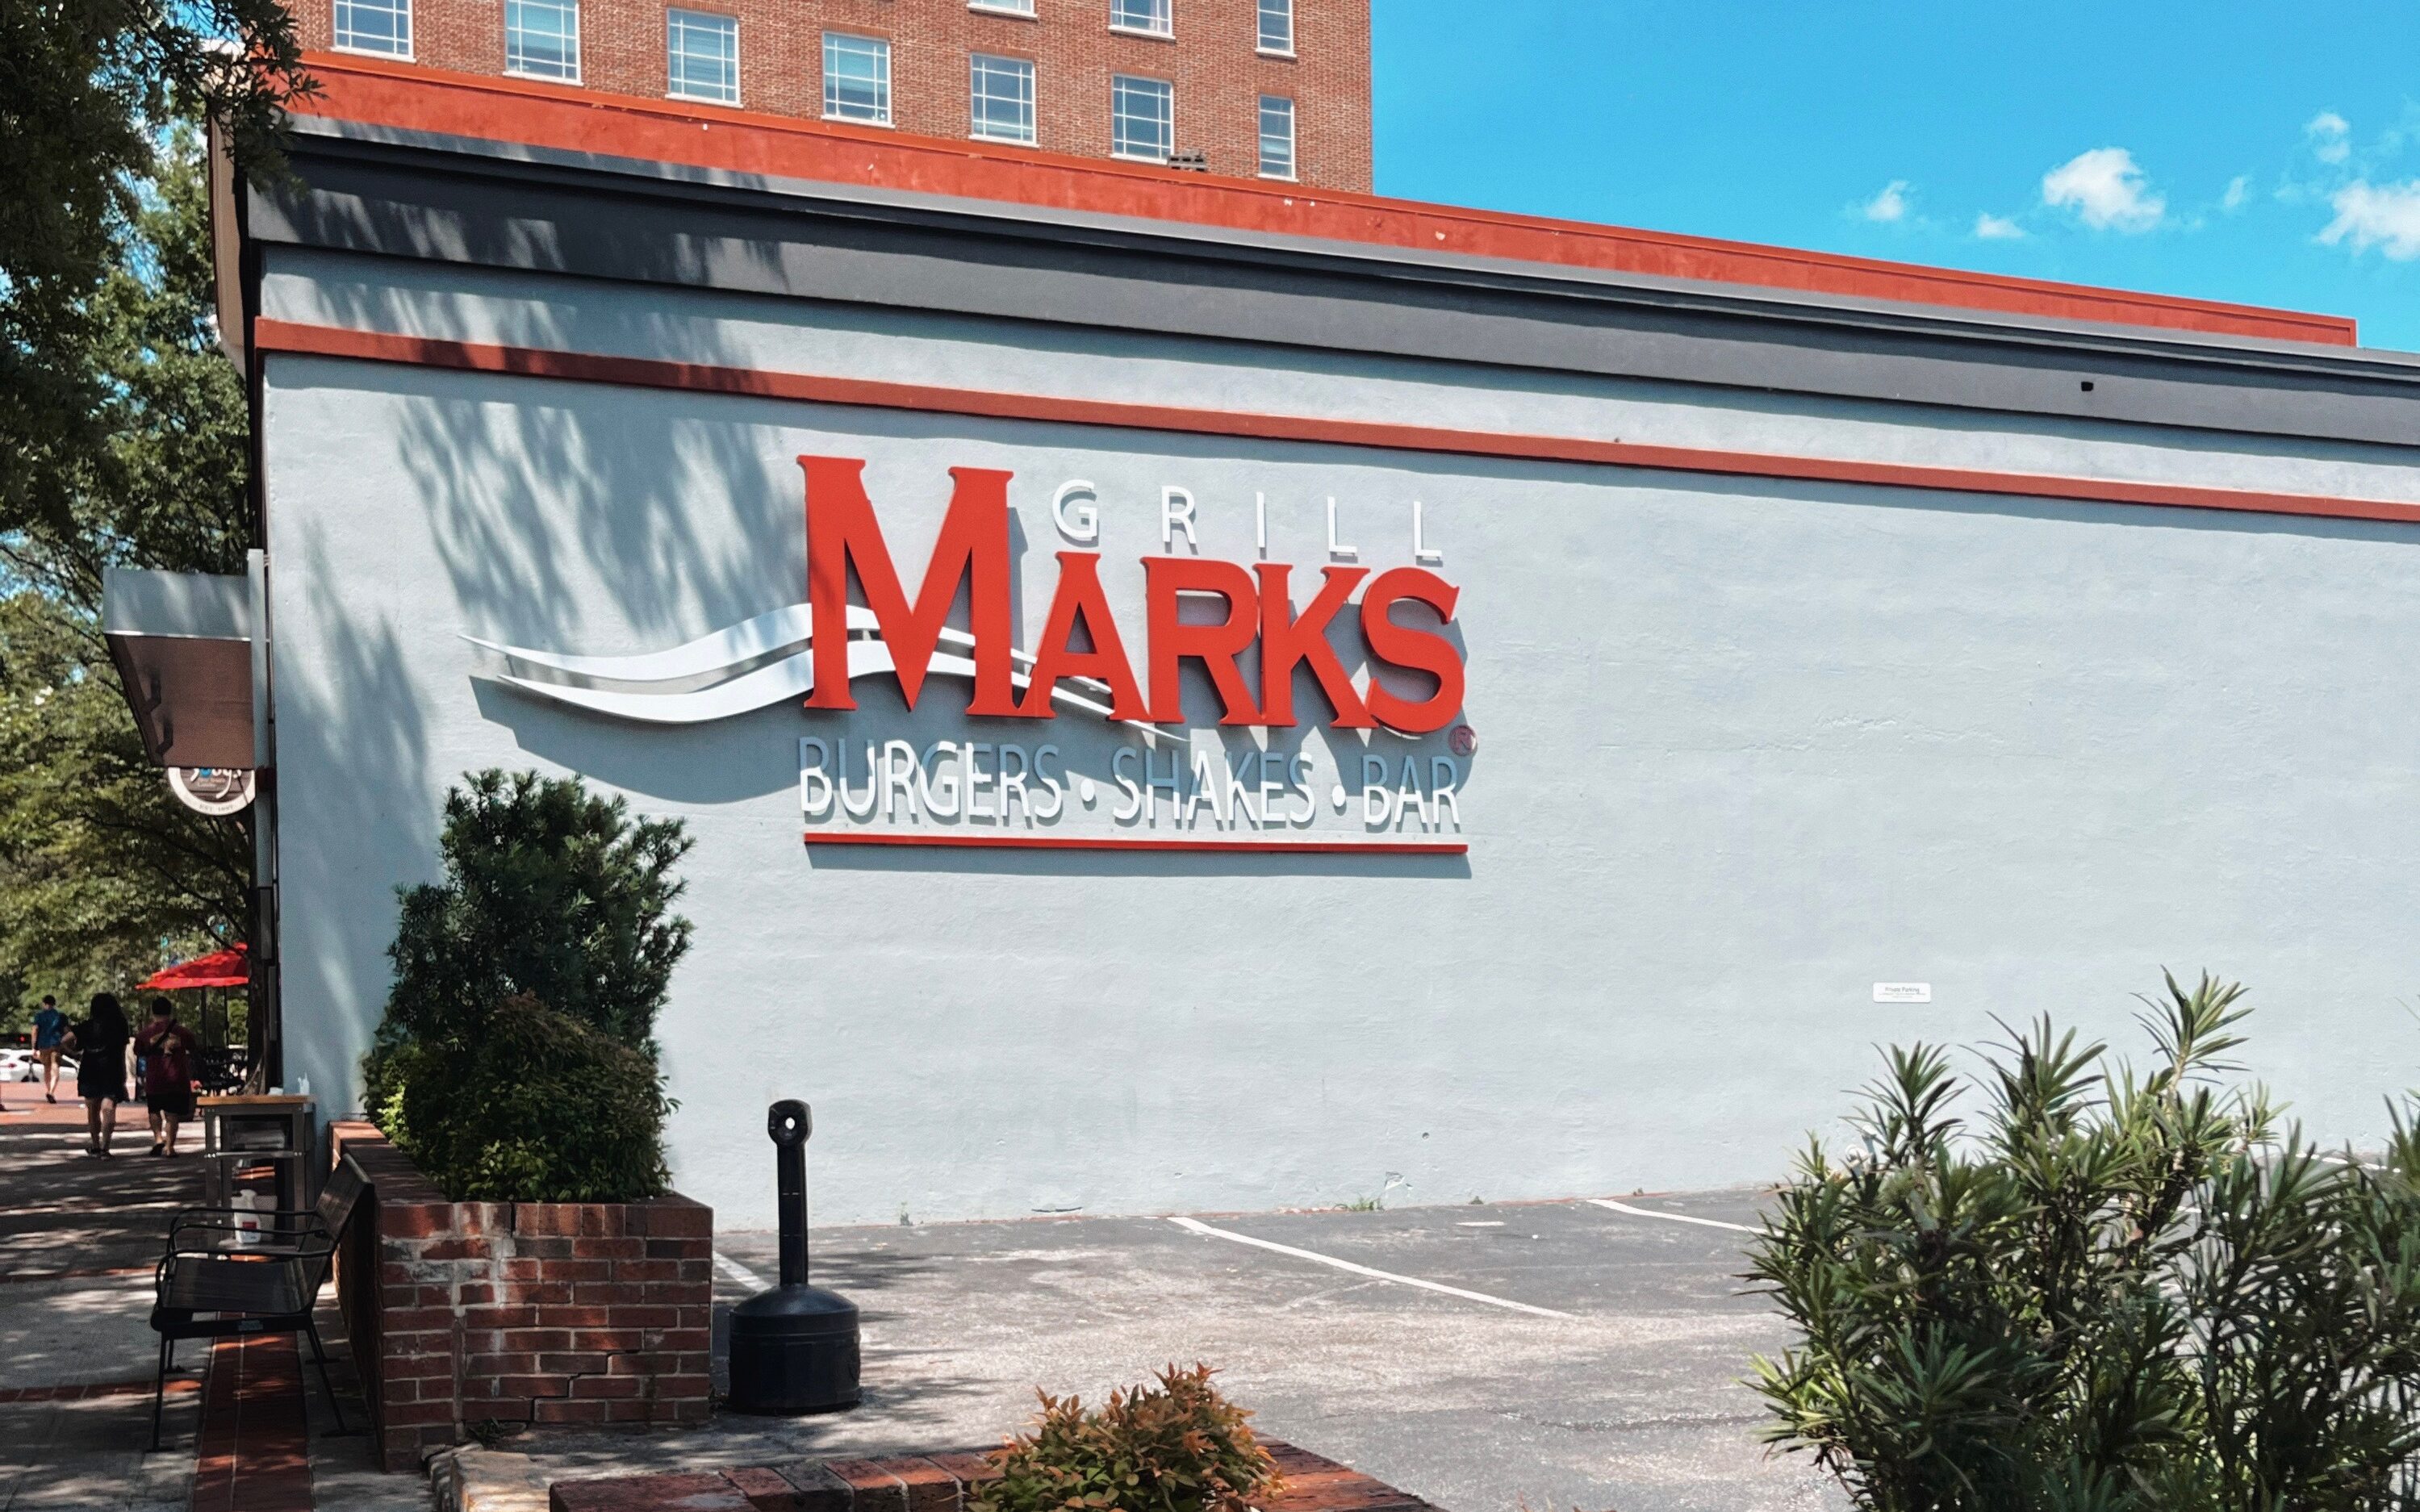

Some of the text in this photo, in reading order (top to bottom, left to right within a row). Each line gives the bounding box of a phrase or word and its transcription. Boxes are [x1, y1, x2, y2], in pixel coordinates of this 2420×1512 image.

[1051, 478, 1442, 558] GRILL
[796, 453, 1465, 733] MARKS
[799, 736, 1460, 825] BURGERS SHAKES BAR
